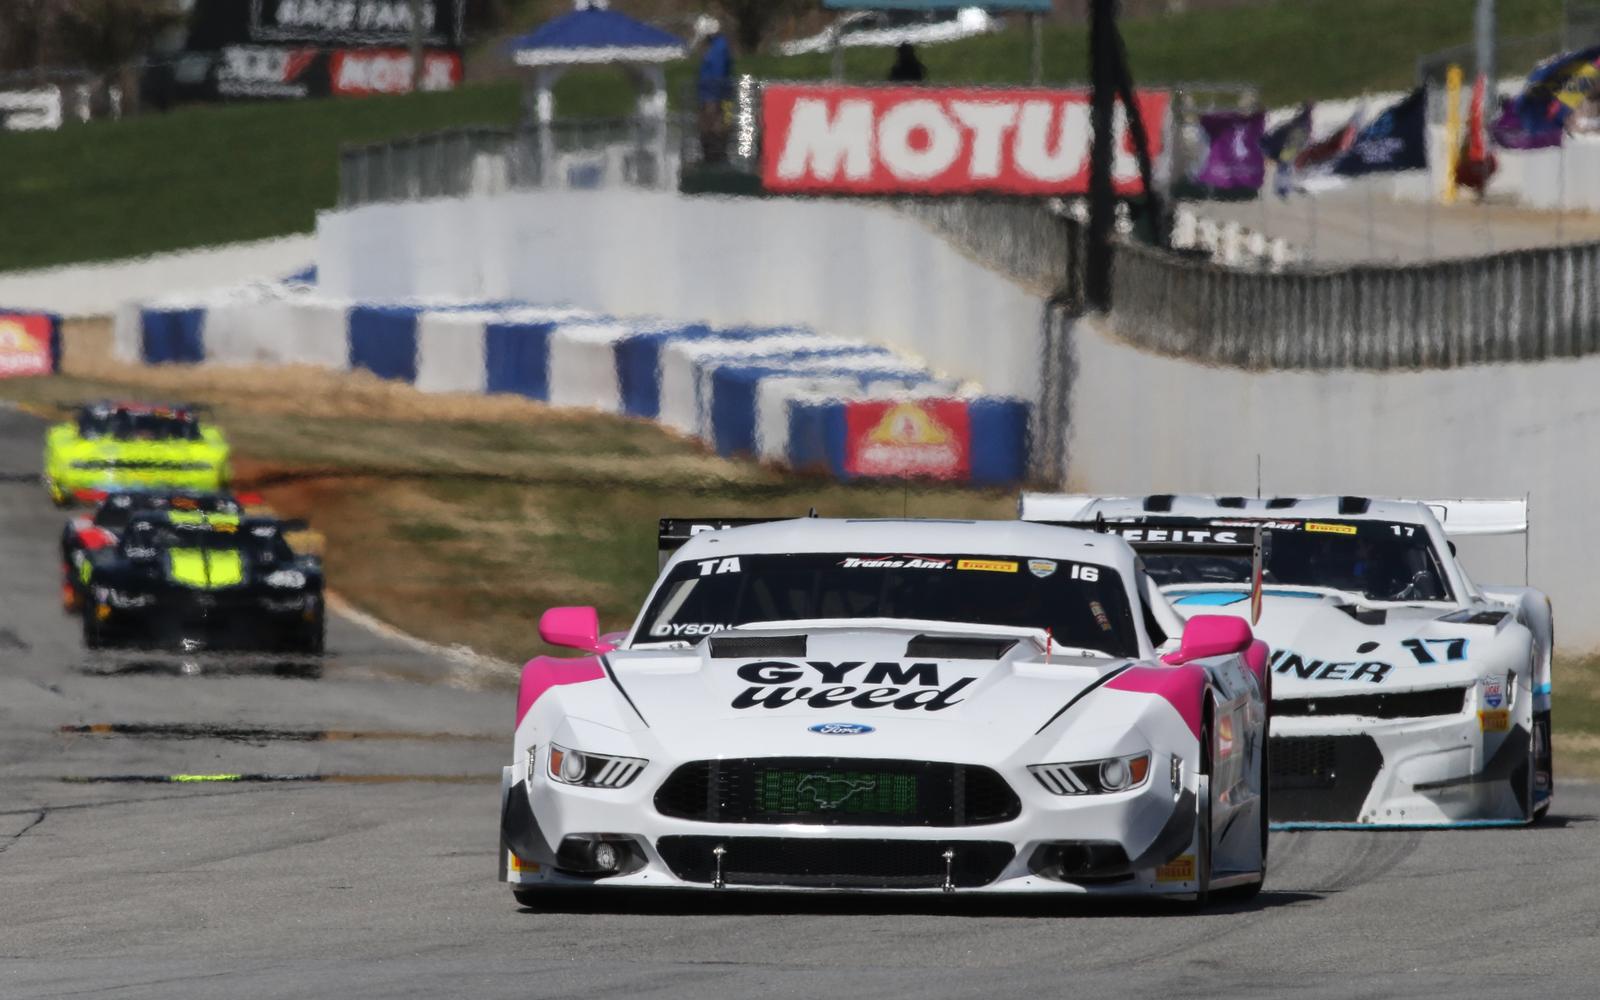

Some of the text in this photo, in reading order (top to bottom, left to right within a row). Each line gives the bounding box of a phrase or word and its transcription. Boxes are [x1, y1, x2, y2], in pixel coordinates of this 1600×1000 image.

[1390, 525, 1414, 536] 17
[697, 557, 741, 576] TA
[843, 557, 946, 569] Trans Am
[1071, 565, 1099, 582] 16
[655, 623, 733, 636] DYSON
[1401, 638, 1469, 664] 17
[736, 661, 940, 686] GYM
[731, 677, 979, 711] weed
